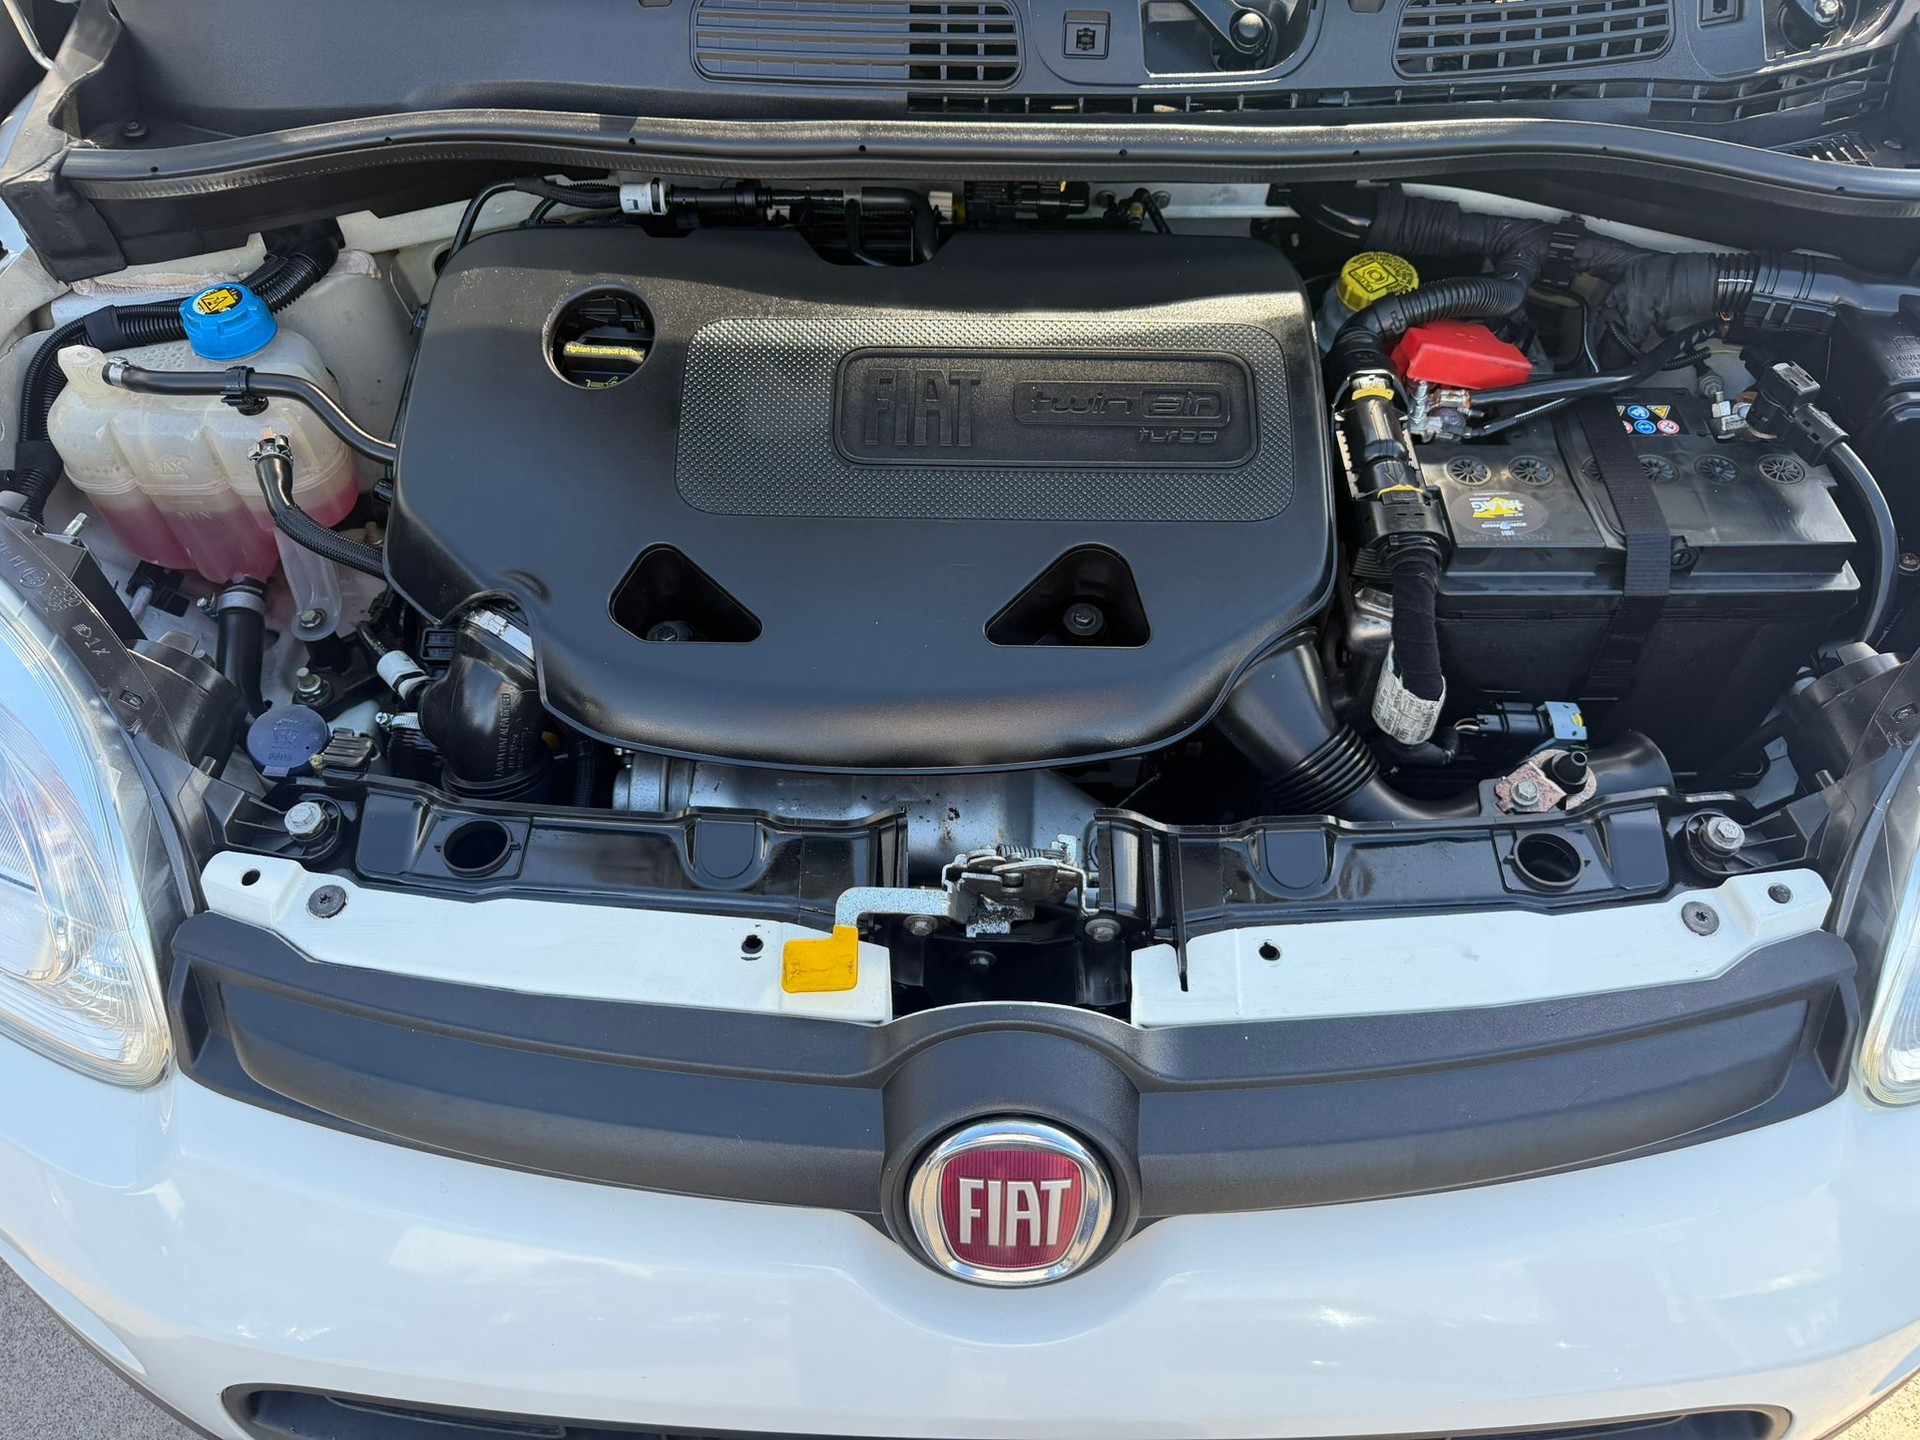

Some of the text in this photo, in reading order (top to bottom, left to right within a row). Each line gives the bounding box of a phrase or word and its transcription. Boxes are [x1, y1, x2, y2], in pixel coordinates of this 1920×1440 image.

[567, 345, 590, 354] Tighten
[600, 347, 619, 355] check
[620, 347, 629, 355] oil
[863, 368, 981, 447] FIAT
[1030, 391, 1212, 415] twin air
[1139, 426, 1219, 443] turbo
[147, 460, 184, 473] MAX
[176, 511, 212, 520] MIN
[959, 1176, 1073, 1247] FIAT
